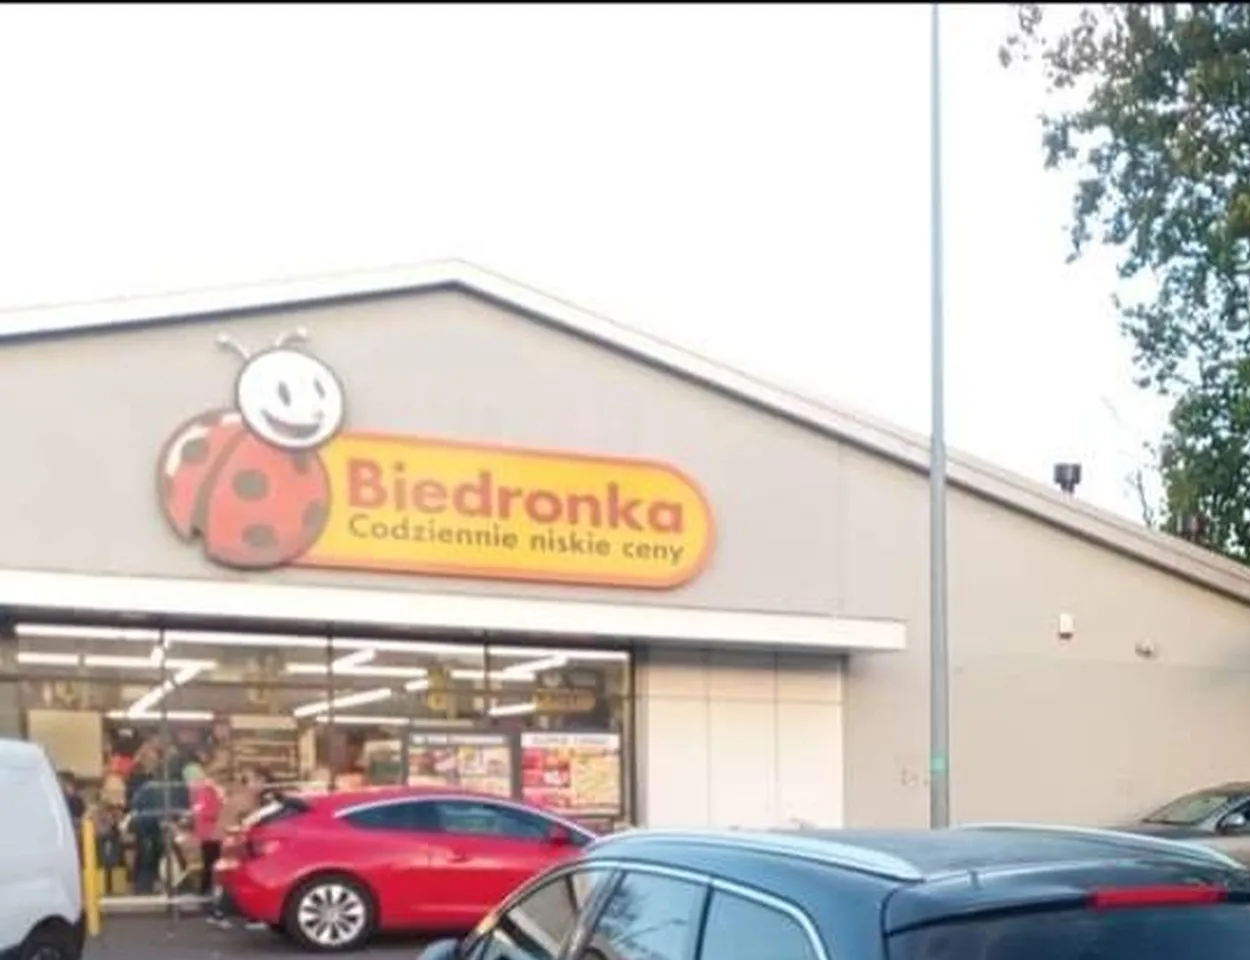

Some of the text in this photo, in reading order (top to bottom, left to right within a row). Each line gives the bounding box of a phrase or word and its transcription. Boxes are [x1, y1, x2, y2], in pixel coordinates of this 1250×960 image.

[346, 456, 684, 534] Biedronka
[348, 513, 685, 566] Codziennie niskie ceny
